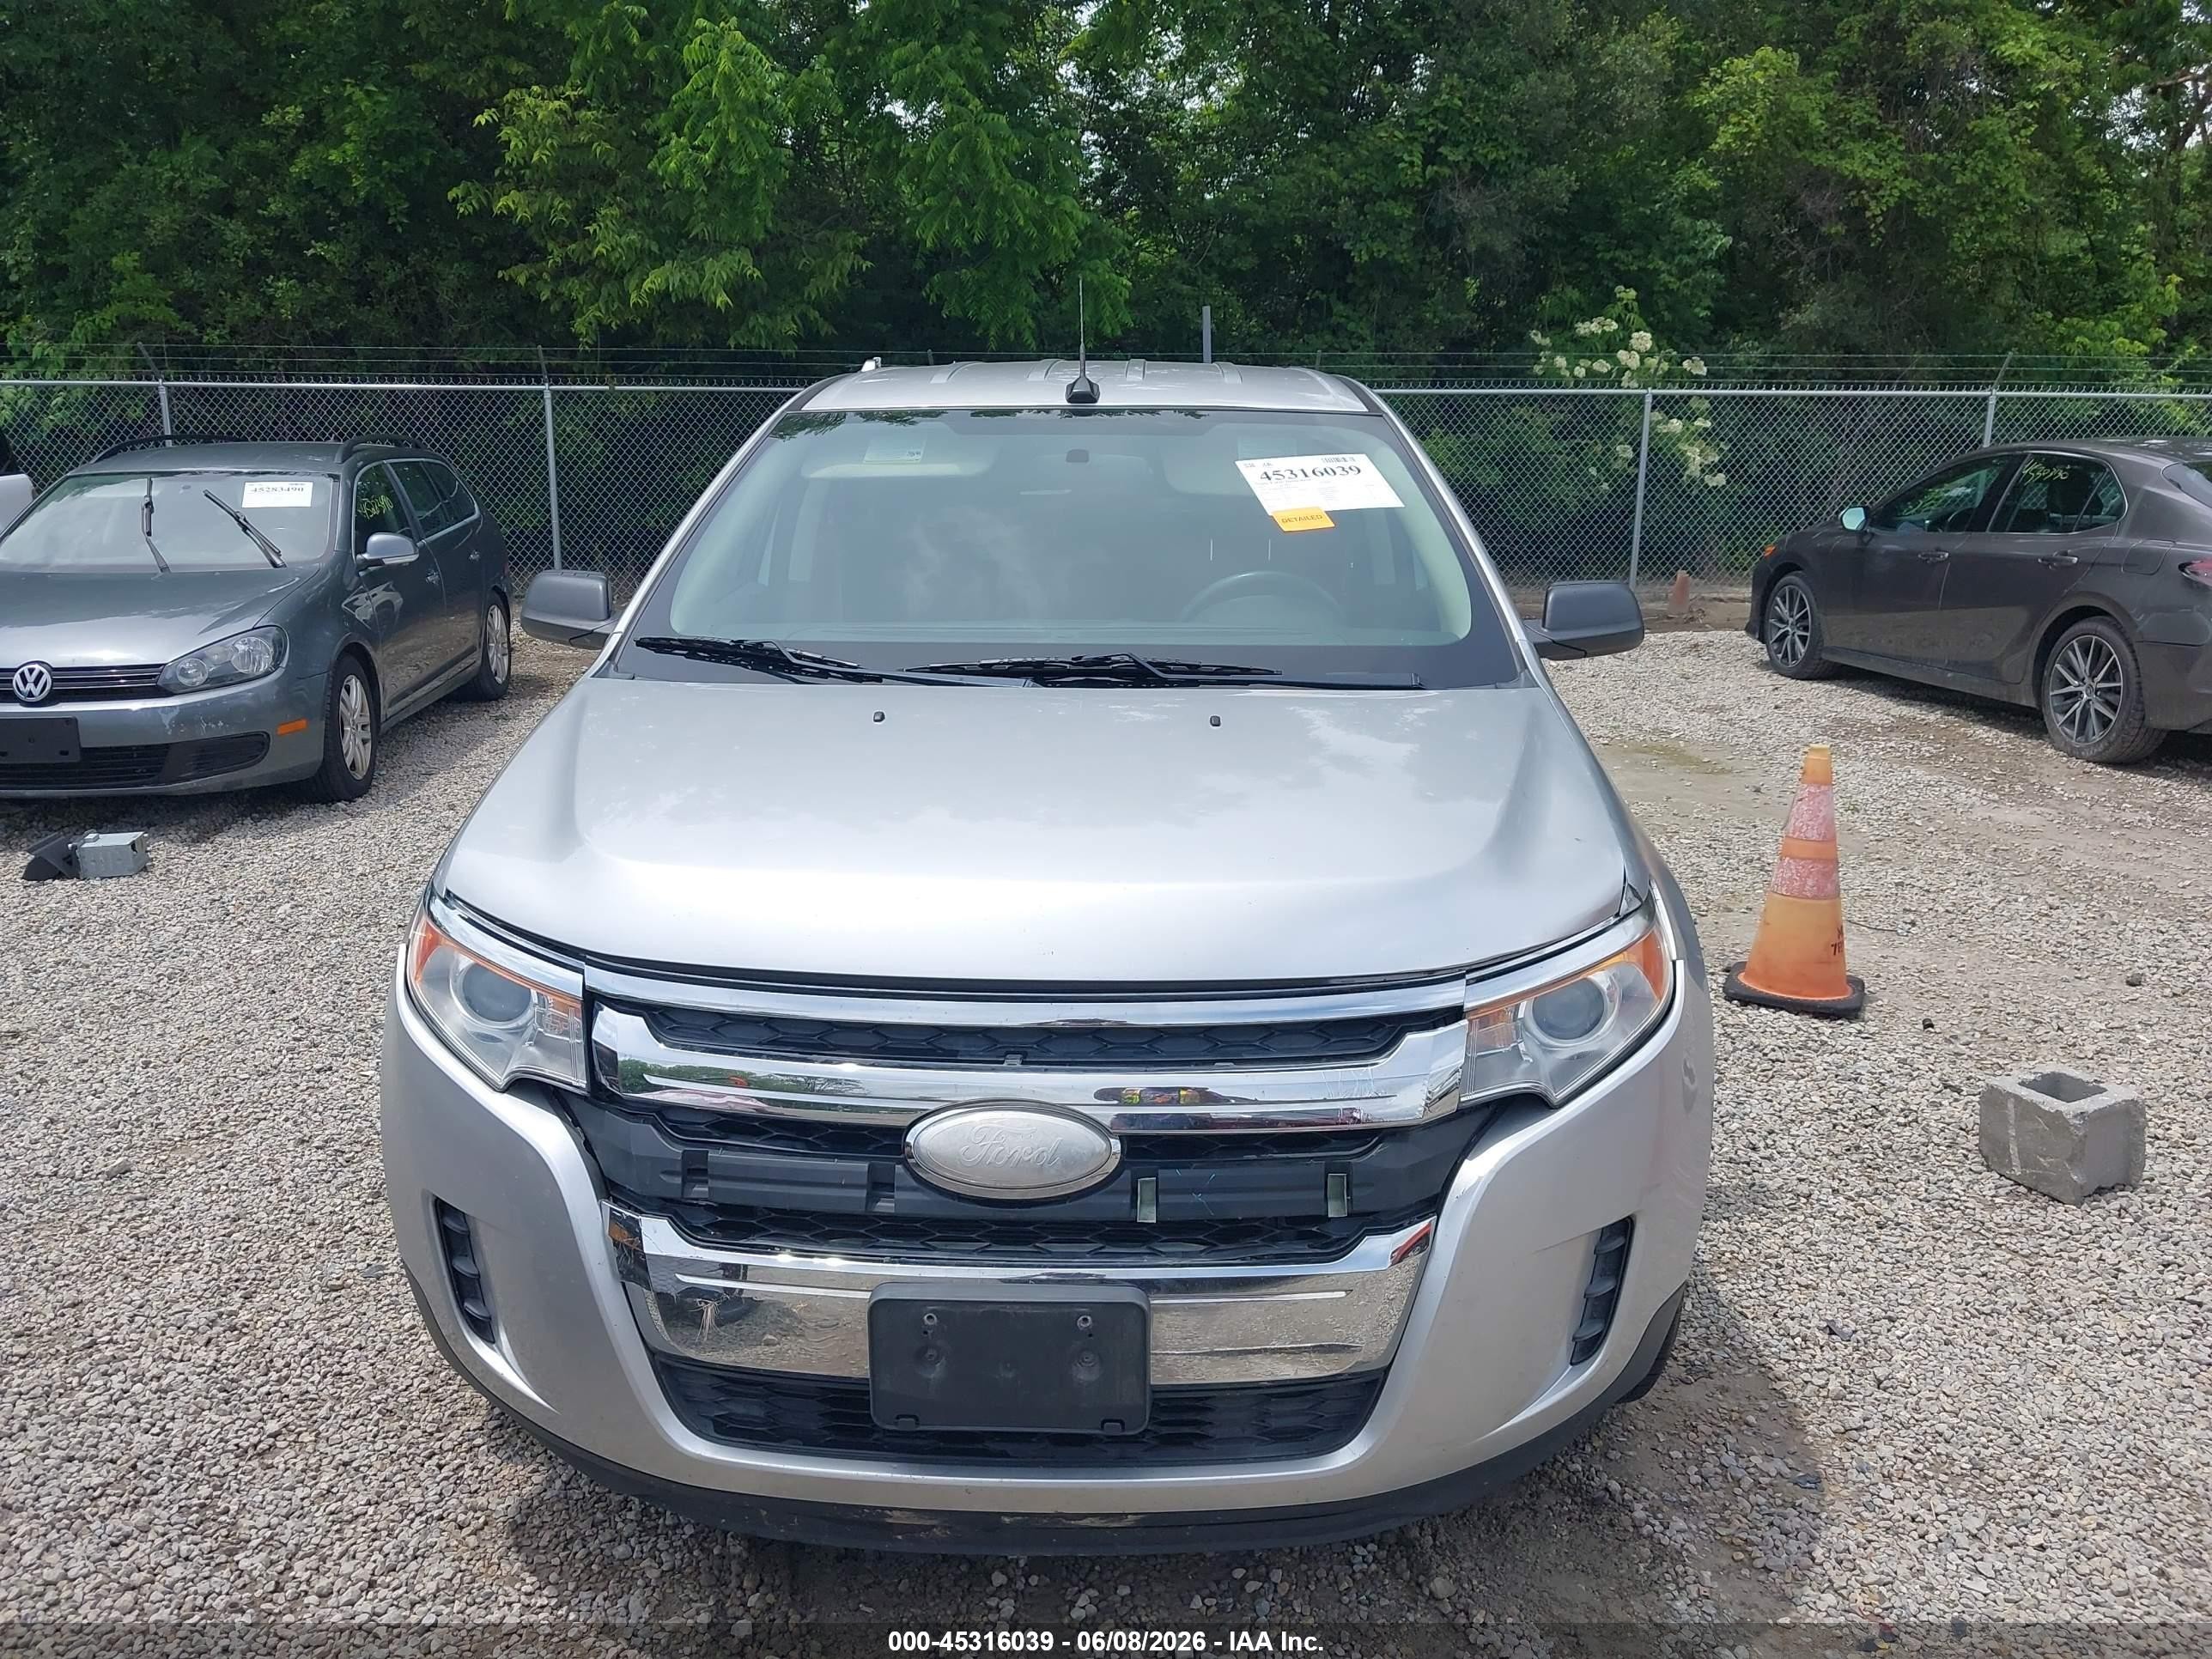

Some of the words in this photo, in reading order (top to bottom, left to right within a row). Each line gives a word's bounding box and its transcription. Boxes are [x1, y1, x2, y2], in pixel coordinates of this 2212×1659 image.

[1260, 465, 1361, 482] 45316039
[1281, 514, 1323, 524] DETAILED
[960, 1120, 1063, 1168] Ford
